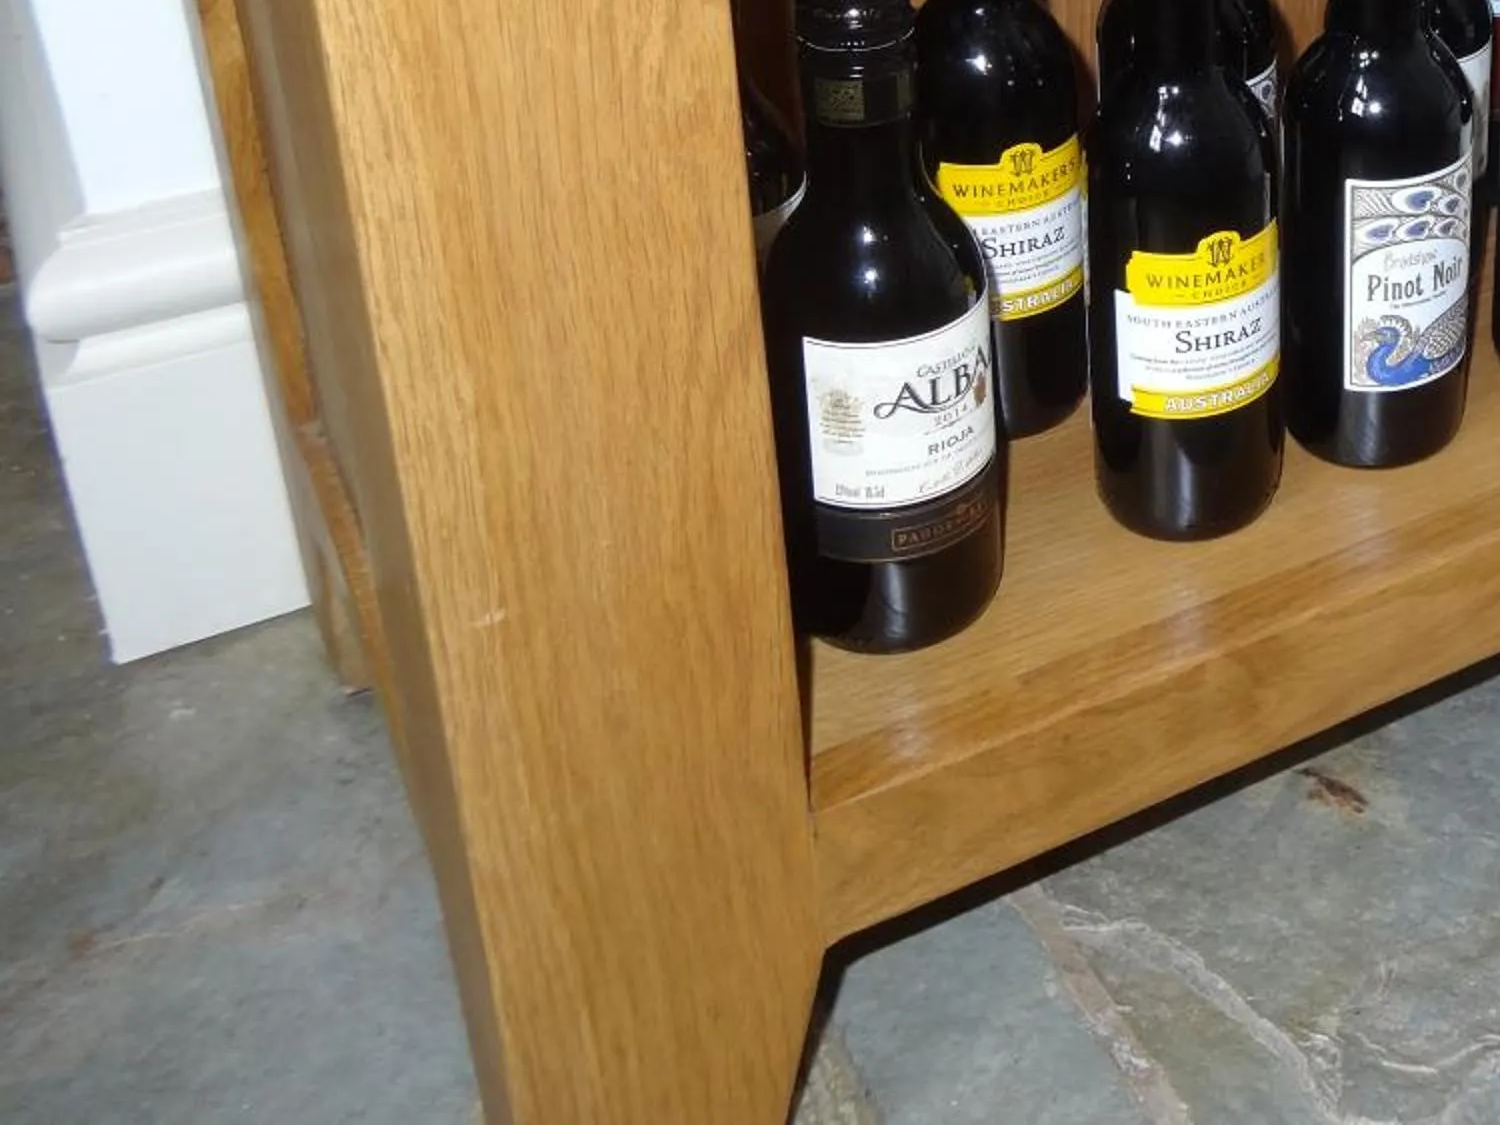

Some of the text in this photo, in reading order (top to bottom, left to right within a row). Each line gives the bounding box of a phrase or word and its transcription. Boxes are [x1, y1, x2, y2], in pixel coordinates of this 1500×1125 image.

[981, 226, 1065, 260] SHIRAZ
[1367, 272, 1424, 302] Pinot
[1433, 255, 1463, 291] Noir
[1175, 317, 1262, 354] SHIRAZ
[928, 426, 975, 456] RIOJA
